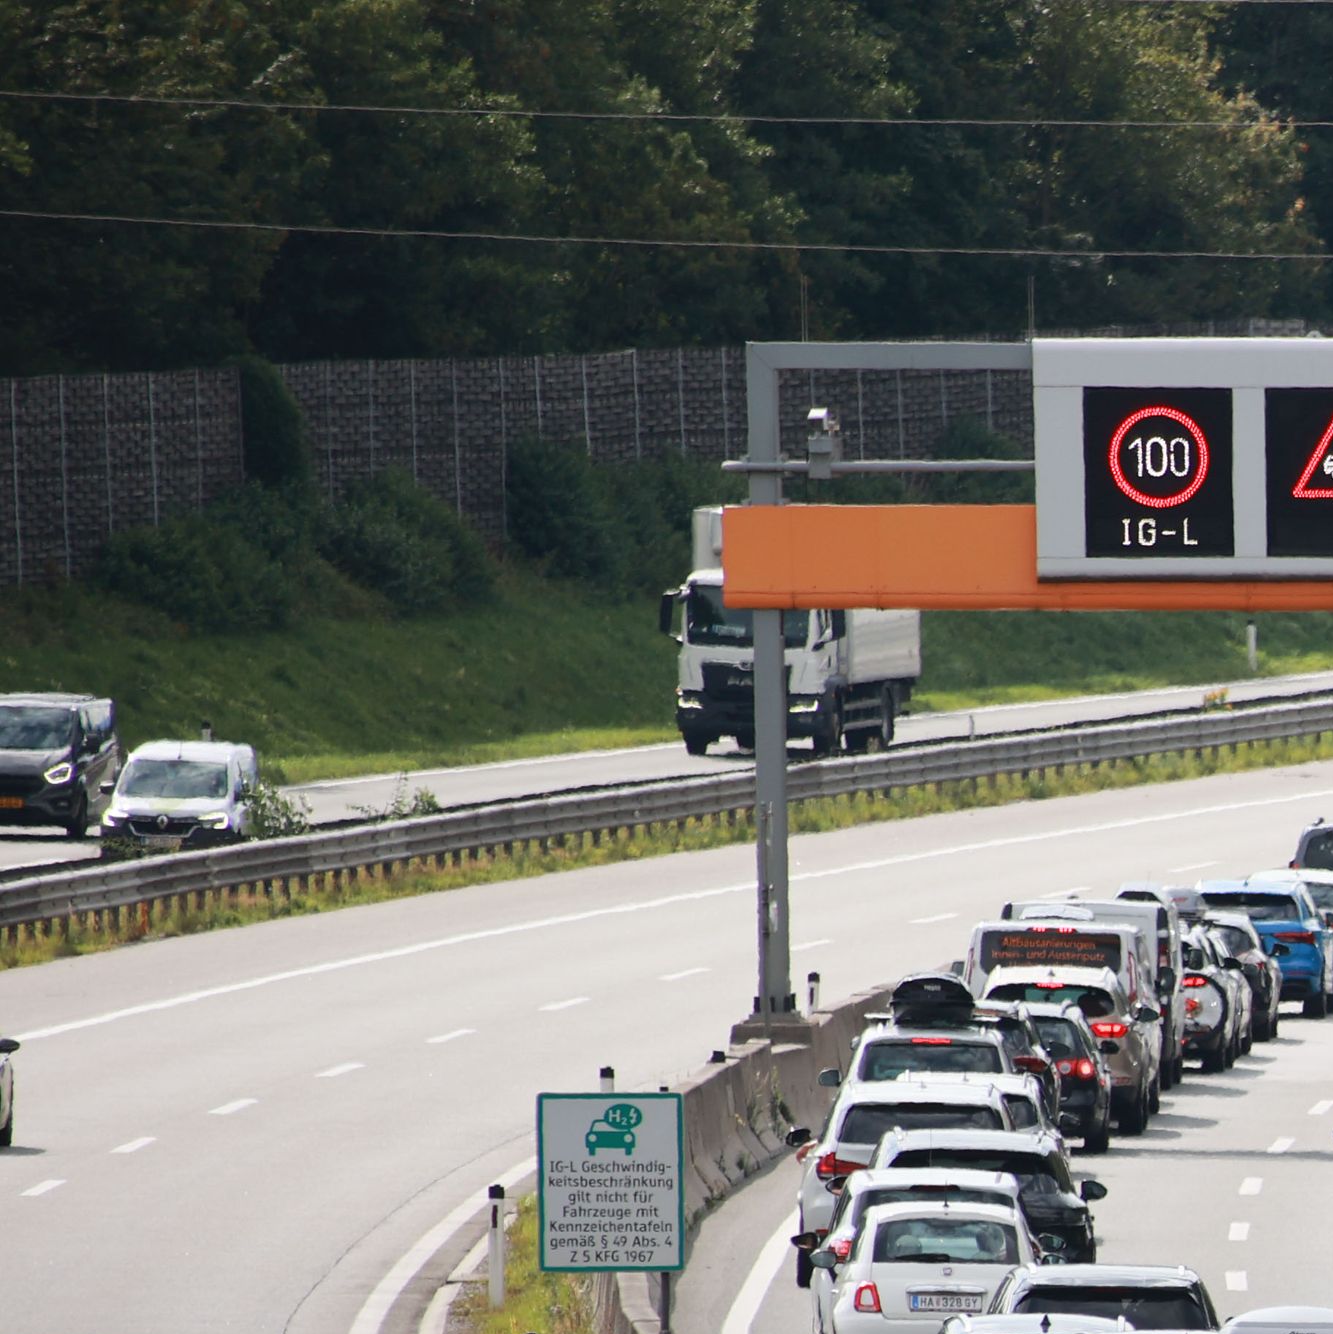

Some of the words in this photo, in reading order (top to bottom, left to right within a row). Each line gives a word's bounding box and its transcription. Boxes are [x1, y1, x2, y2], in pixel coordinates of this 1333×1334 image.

[1128, 437, 1190, 477] 100
[1122, 517, 1198, 546] IG-L
[550, 1161, 577, 1173] IG-L
[582, 1160, 671, 1175] Geschwindig-
[548, 1176, 673, 1190] keitsbeschränkung
[568, 1190, 591, 1205] gilt
[596, 1190, 628, 1203] nicht
[633, 1190, 653, 1203] für
[563, 1205, 631, 1220] Fahrzeuge
[636, 1205, 659, 1217] mit
[549, 1220, 673, 1232] Kennzeichentafeln
[550, 1235, 595, 1249] gemäß
[600, 1234, 608, 1249] §
[613, 1236, 627, 1247] 49
[632, 1235, 660, 1247] Abs.
[664, 1235, 672, 1247] 4
[570, 1250, 578, 1262] Z
[583, 1250, 590, 1262] 5
[595, 1250, 619, 1262] KFG
[624, 1250, 654, 1262] 1967
[921, 1297, 934, 1307] HA
